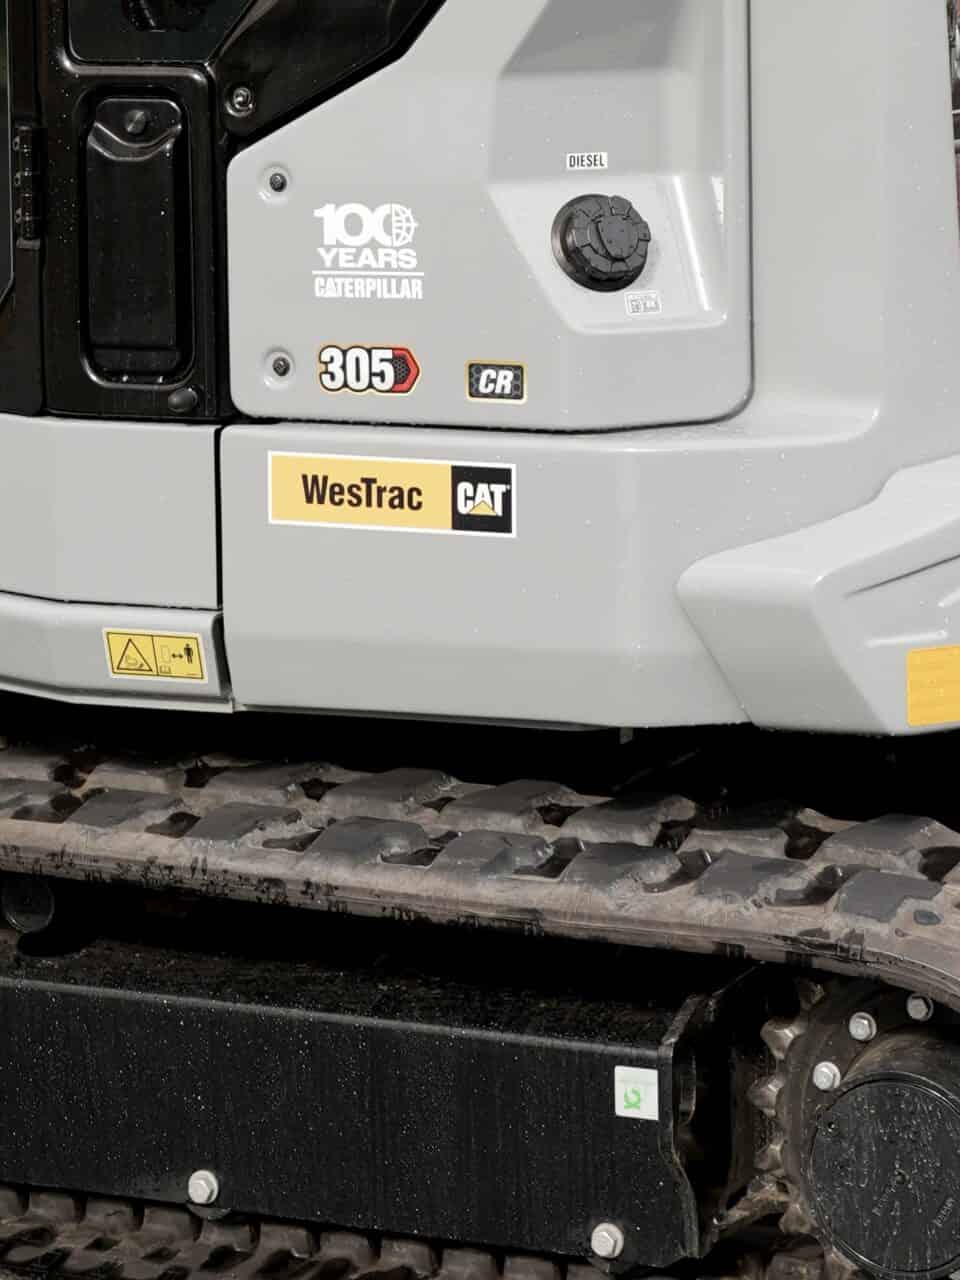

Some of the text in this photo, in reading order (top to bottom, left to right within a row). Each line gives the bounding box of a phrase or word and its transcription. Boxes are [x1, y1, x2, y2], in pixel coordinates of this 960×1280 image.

[569, 154, 605, 168] DIESEL
[313, 202, 418, 248] 100
[316, 247, 418, 269] YEARS
[314, 276, 425, 300] CATERPILLAR
[319, 345, 396, 393] 305
[479, 368, 514, 394] CR
[301, 473, 509, 517] WesTrac CAT
